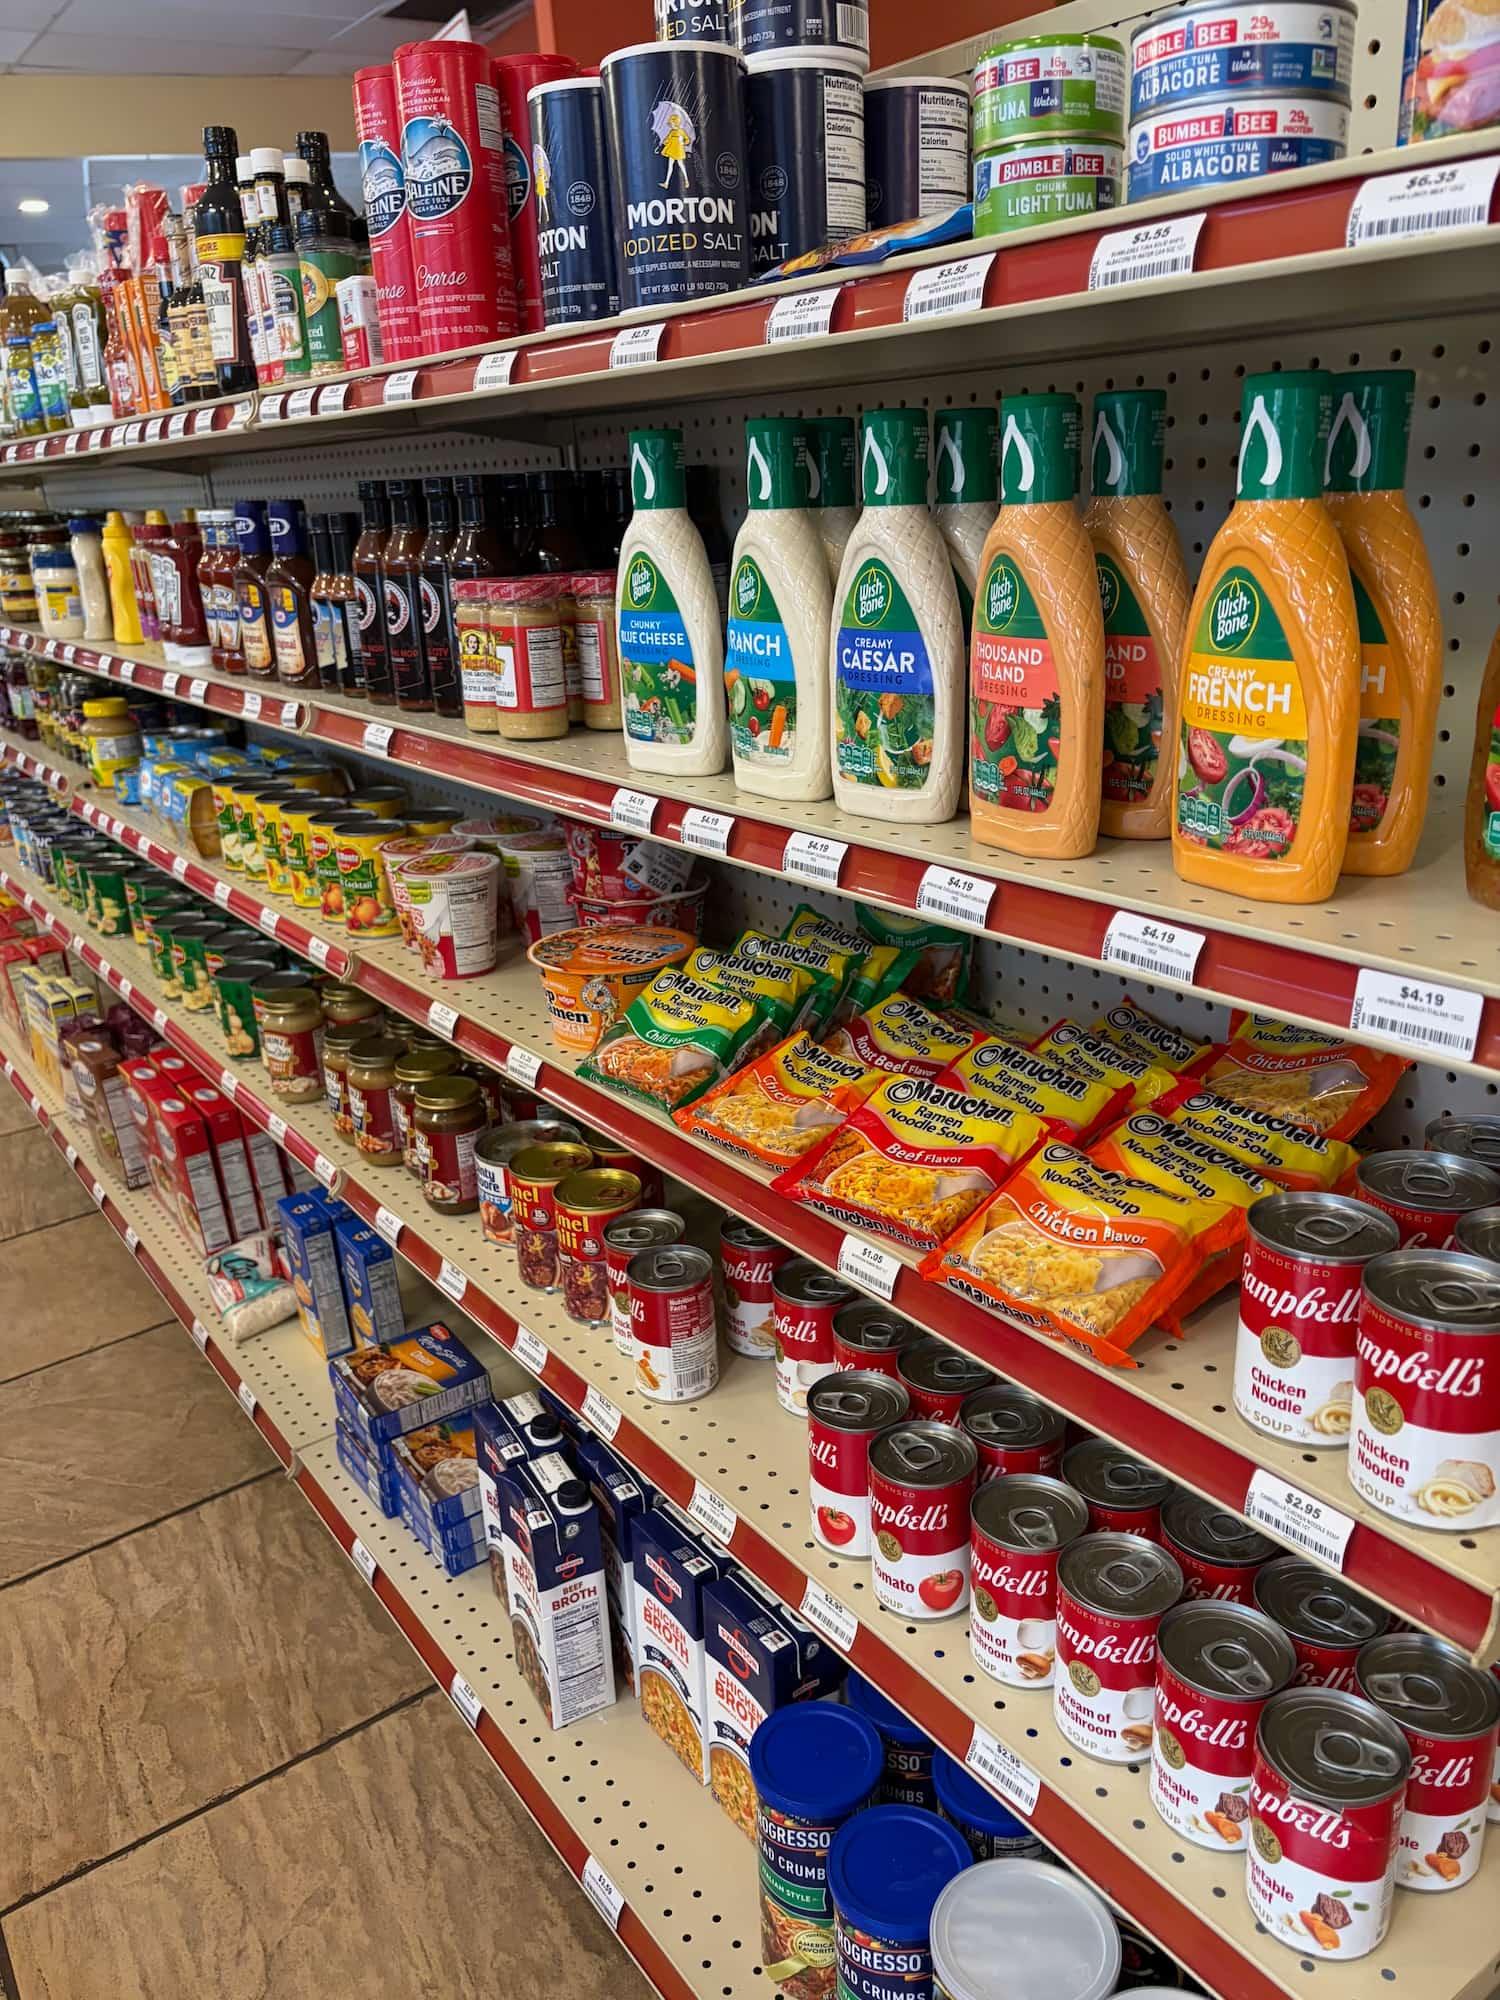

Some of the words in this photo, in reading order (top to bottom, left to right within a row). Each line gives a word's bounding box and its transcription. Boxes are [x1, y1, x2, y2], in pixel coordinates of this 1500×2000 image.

[1243, 31, 1281, 42] PROTEIN
[1250, 17, 1275, 33] 29g
[1136, 31, 1184, 68] BUMBLE
[1197, 25, 1231, 46] BEE
[1007, 63, 1035, 80] BEE
[1043, 69, 1074, 79] PROTEIN
[1049, 57, 1068, 72] 16g
[1142, 65, 1163, 82] SOLID
[1162, 58, 1188, 74] WHITE
[1191, 52, 1218, 67] TUNA
[1231, 60, 1261, 74] Water
[826, 78, 855, 94] Nutrition
[1139, 63, 1221, 104] ALBACORE
[920, 94, 954, 106] Nutrition
[1033, 96, 1060, 109] Water
[991, 101, 1028, 128] TUNA
[1289, 110, 1309, 128] 29g
[826, 121, 852, 137] Calories
[920, 137, 948, 148] Calories
[1158, 121, 1222, 148] BUMBLE
[1237, 114, 1271, 133] BEE
[1282, 128, 1314, 137] PROTEIN
[1165, 150, 1192, 164] SOLID
[1193, 147, 1227, 161] WHITE
[1231, 143, 1260, 155] TUNA
[1271, 150, 1299, 164] Water
[1003, 161, 1061, 183] BUMBLE
[1075, 157, 1100, 175] BEE
[1160, 153, 1262, 185] ALBACORE
[1406, 168, 1459, 191] $6.35
[1035, 183, 1068, 196] CHUNK
[627, 197, 735, 230] MORTON
[1007, 195, 1050, 218] LIGHT
[1055, 191, 1096, 212] TUNA
[624, 232, 698, 258] IODIZED
[703, 232, 743, 252] SALT
[1131, 227, 1171, 245] $3.55
[415, 264, 468, 293] Coarse
[936, 262, 970, 281] $3.55
[632, 582, 652, 601] Bone
[859, 576, 886, 603] Wish-
[989, 574, 1014, 603] Wish-
[860, 597, 886, 619] Bone
[990, 597, 1013, 621] Bone
[1216, 595, 1251, 621] Wish-
[630, 618, 661, 633] CHUNKY
[1215, 612, 1250, 642] Bone
[639, 633, 685, 649] CHEESE
[730, 629, 781, 657] RANCH
[856, 637, 893, 653] CREAMY
[976, 641, 1043, 667] THOUSAND
[842, 647, 915, 676] CAESAR
[981, 662, 1025, 684] ISLAND
[1207, 664, 1257, 683] CREAMY
[849, 673, 904, 687] DRESSING
[1187, 672, 1293, 715] FRENCH
[1196, 709, 1267, 729] DRESSING
[701, 814, 719, 827] $4.19
[808, 838, 829, 855] $4.19
[948, 875, 974, 892] $4.19
[1140, 925, 1175, 946] $4.19
[716, 952, 793, 985] Maruchan
[758, 939, 831, 973] Maruchan
[717, 970, 755, 989] Ramen
[668, 994, 703, 1012] Ramen
[1399, 985, 1444, 1007] $4.19
[650, 997, 683, 1021] Noodle
[683, 1009, 709, 1029] Soup
[1351, 996, 1364, 1030] MANDEL
[645, 1029, 671, 1046] Chili
[1255, 1028, 1307, 1045] Noodle
[1308, 1032, 1345, 1046] Soup
[854, 1034, 878, 1065] Roast
[876, 1053, 909, 1078] Beef
[909, 1064, 938, 1078] Flavor
[1065, 1048, 1106, 1079] Ramen
[1246, 1052, 1306, 1071] Chicken
[781, 1054, 817, 1089] Noodle
[801, 1064, 839, 1087] Ramen
[995, 1069, 1038, 1096] Ramen
[998, 1043, 1084, 1100] Maruchan
[912, 1081, 1013, 1124] Maruchan
[969, 1074, 1013, 1102] Noodle
[1011, 1093, 1046, 1115] Soup
[886, 1107, 938, 1136] Noodle
[936, 1119, 974, 1146] Soup
[914, 1106, 963, 1129] Ramen
[1211, 1094, 1327, 1152] Maruchan
[1214, 1114, 1271, 1143] Ramen
[887, 1144, 922, 1163] Beef
[924, 1153, 964, 1166] Flavor
[1181, 1116, 1241, 1147] Noodle
[1236, 1137, 1284, 1167] Soup
[1122, 1138, 1176, 1173] Noodle
[1172, 1168, 1217, 1199] Soup
[1152, 1143, 1207, 1175] Ramen
[1158, 1122, 1260, 1189] Maruchan
[1042, 1167, 1097, 1201] Noodle
[818, 1202, 885, 1233] Maruchan
[1028, 1200, 1098, 1243] Chicken
[1102, 1225, 1148, 1246] Flavor
[861, 1245, 883, 1263] $1.05
[1255, 1246, 1332, 1279] CONDENSED
[1357, 1332, 1484, 1398] mpbell's
[1251, 1366, 1307, 1400] Chicken
[1251, 1383, 1303, 1416] Noodle
[1253, 1410, 1294, 1436] SOUP
[1356, 1428, 1410, 1472] Chicken
[1356, 1452, 1406, 1489] Noodle
[1357, 1478, 1397, 1507] SOUP
[869, 1486, 950, 1533] mpbell's
[1285, 1492, 1323, 1521] $2.95
[875, 1559, 916, 1594] Tomato
[970, 1550, 1049, 1597] mpbell's
[551, 1585, 598, 1612] BROTH
[562, 1582, 584, 1597] BEEF
[645, 1597, 688, 1647] CHICKEN
[643, 1607, 689, 1665] BROTH
[994, 1638, 1008, 1650] of
[717, 1670, 764, 1724] CHICKEN
[1060, 1686, 1095, 1720] Cream
[1096, 1712, 1111, 1726] of
[1059, 1695, 1117, 1740] Mushroom
[1156, 1685, 1247, 1749] mpbell's
[1066, 1725, 1100, 1754] SOUP
[996, 1743, 1022, 1769] $2.95
[777, 1850, 827, 1881] CRUMB
[785, 1887, 811, 1904] STYLE
